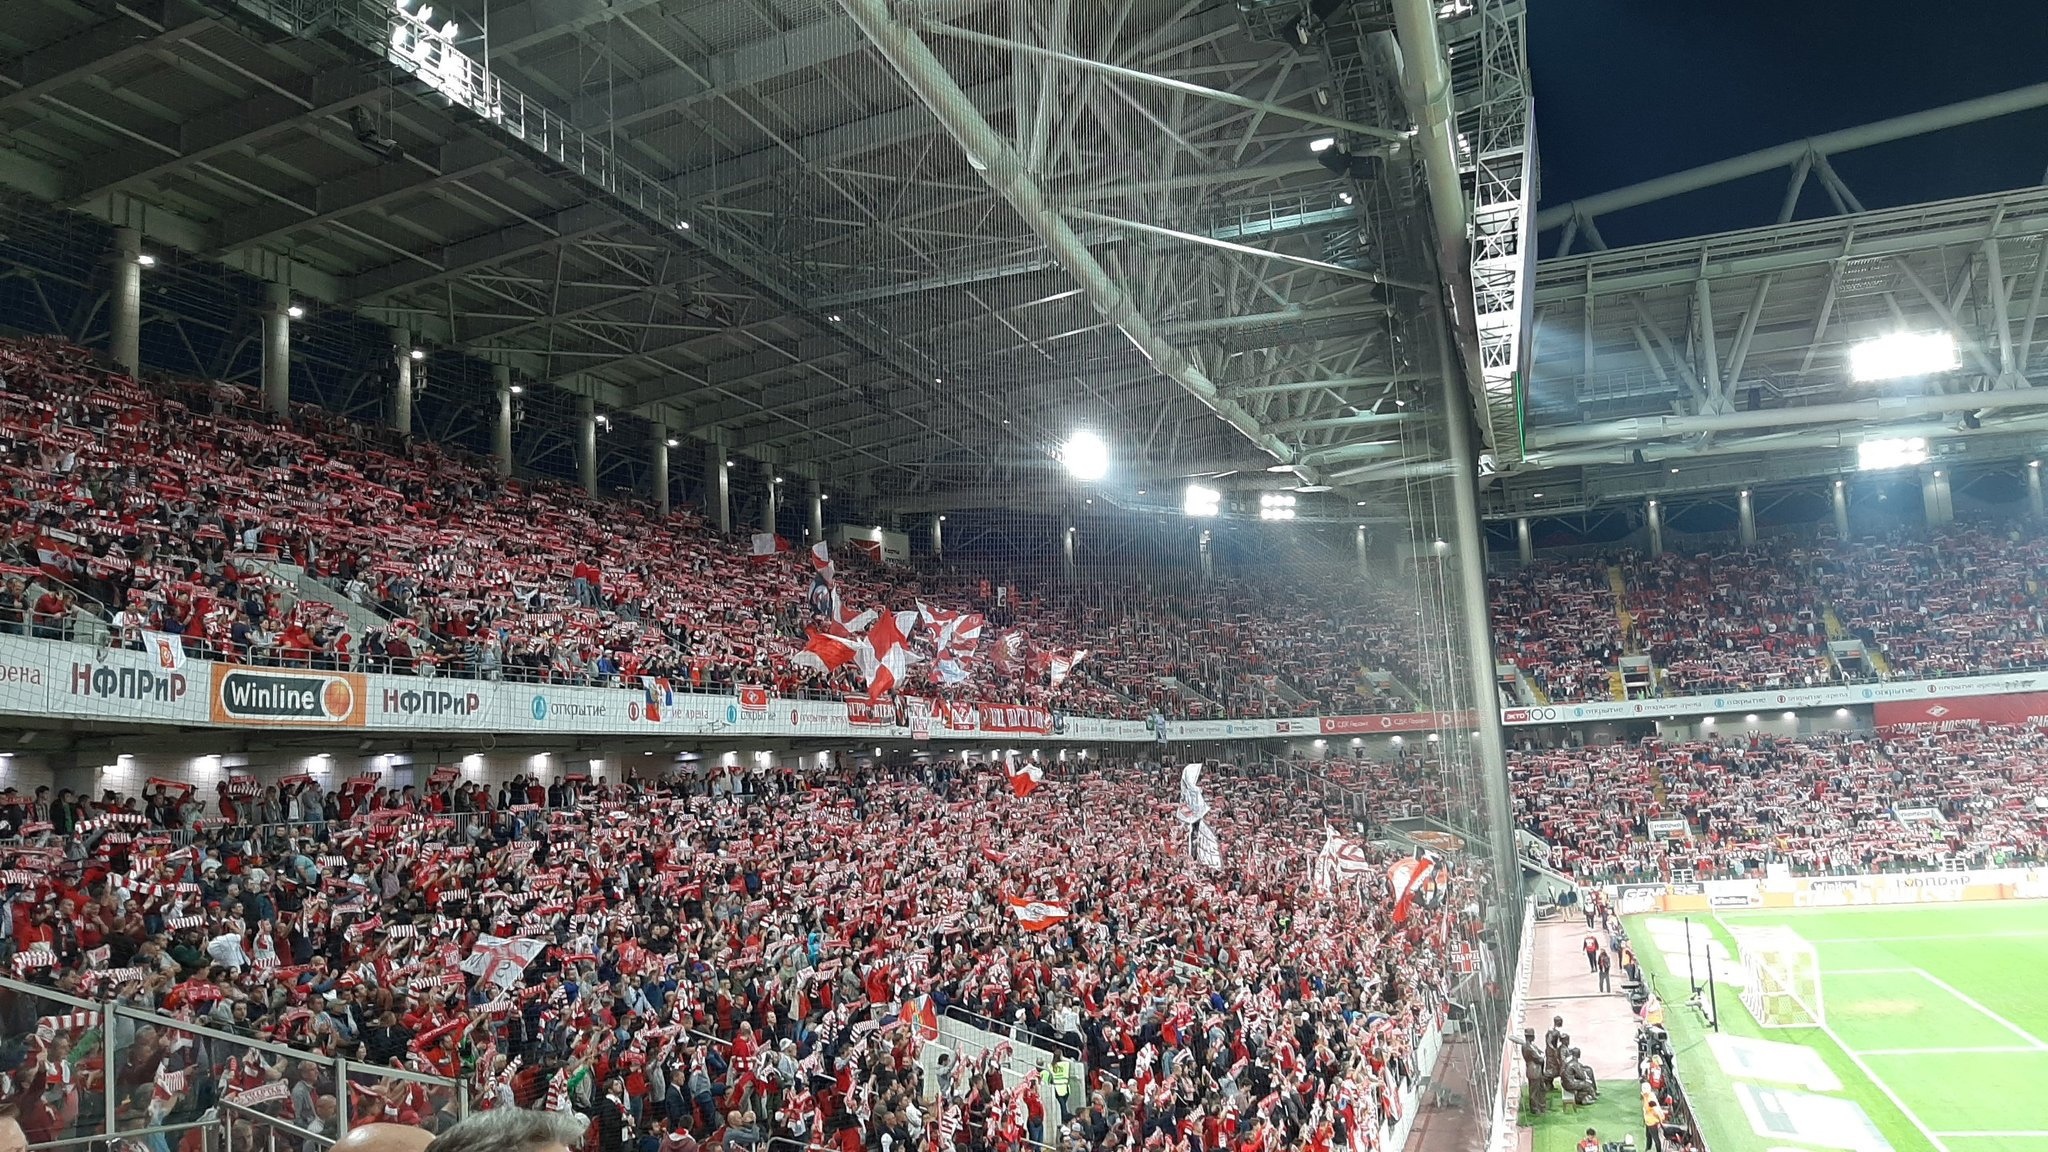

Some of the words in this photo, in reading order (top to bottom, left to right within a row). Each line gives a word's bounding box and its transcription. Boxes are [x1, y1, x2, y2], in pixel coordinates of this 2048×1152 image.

[231, 680, 315, 711] Winline
[382, 688, 481, 716] НФПРиР
[551, 702, 607, 720] открытие
